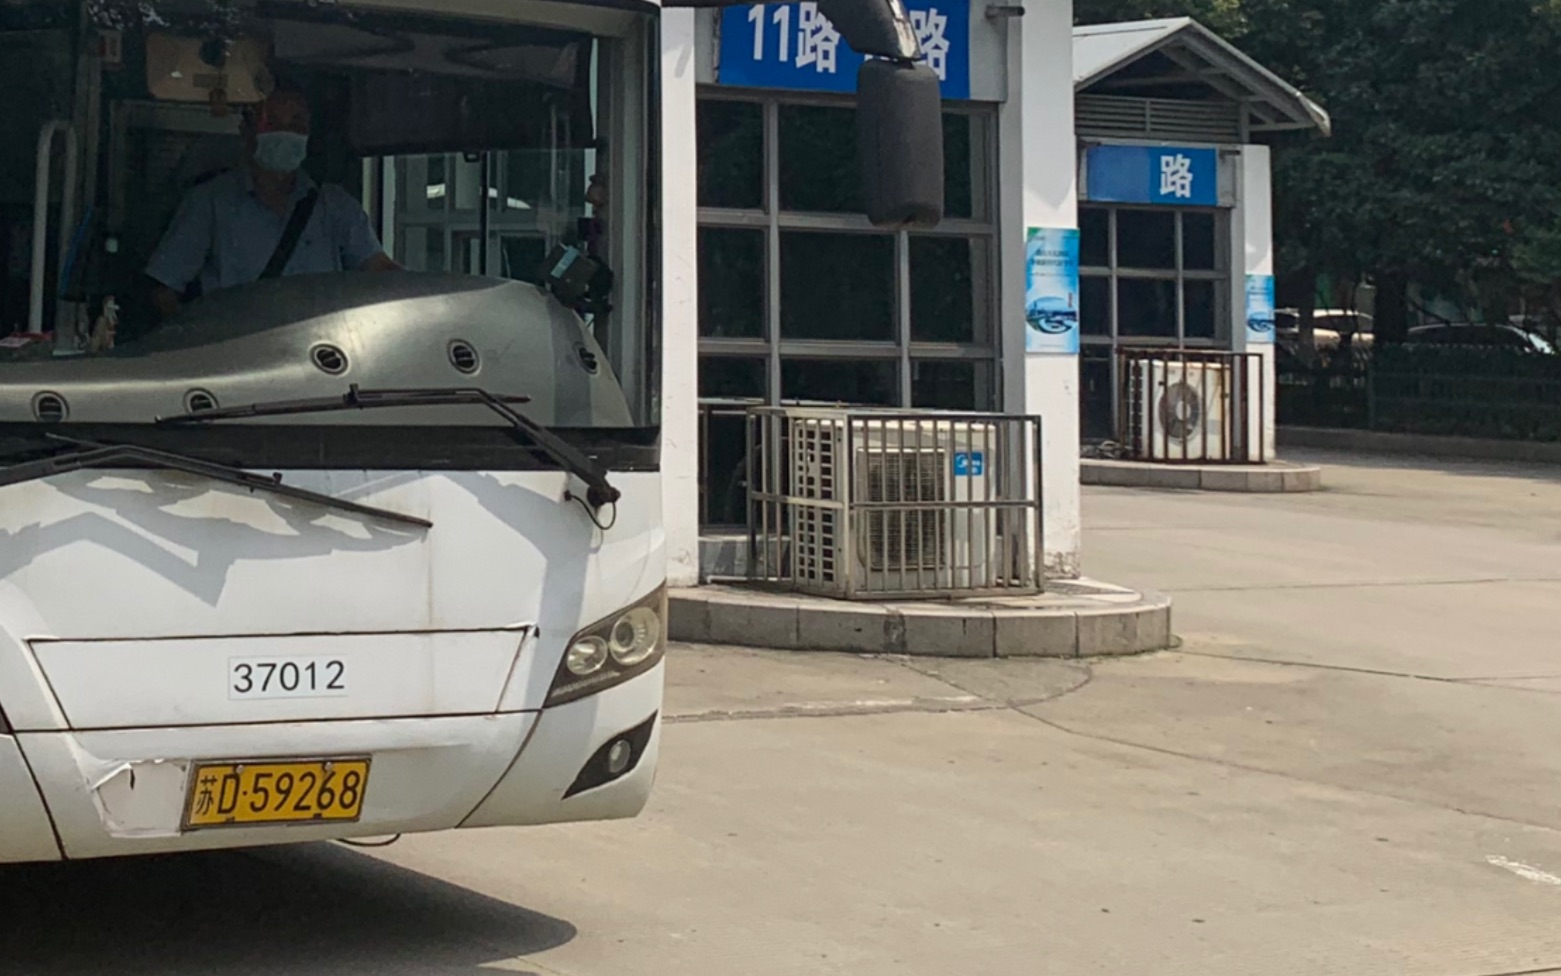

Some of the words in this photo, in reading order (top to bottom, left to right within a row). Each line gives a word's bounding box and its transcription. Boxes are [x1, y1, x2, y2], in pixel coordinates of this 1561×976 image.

[748, 0, 841, 74] 11路
[1159, 153, 1193, 198] 路
[233, 660, 345, 693] 37012
